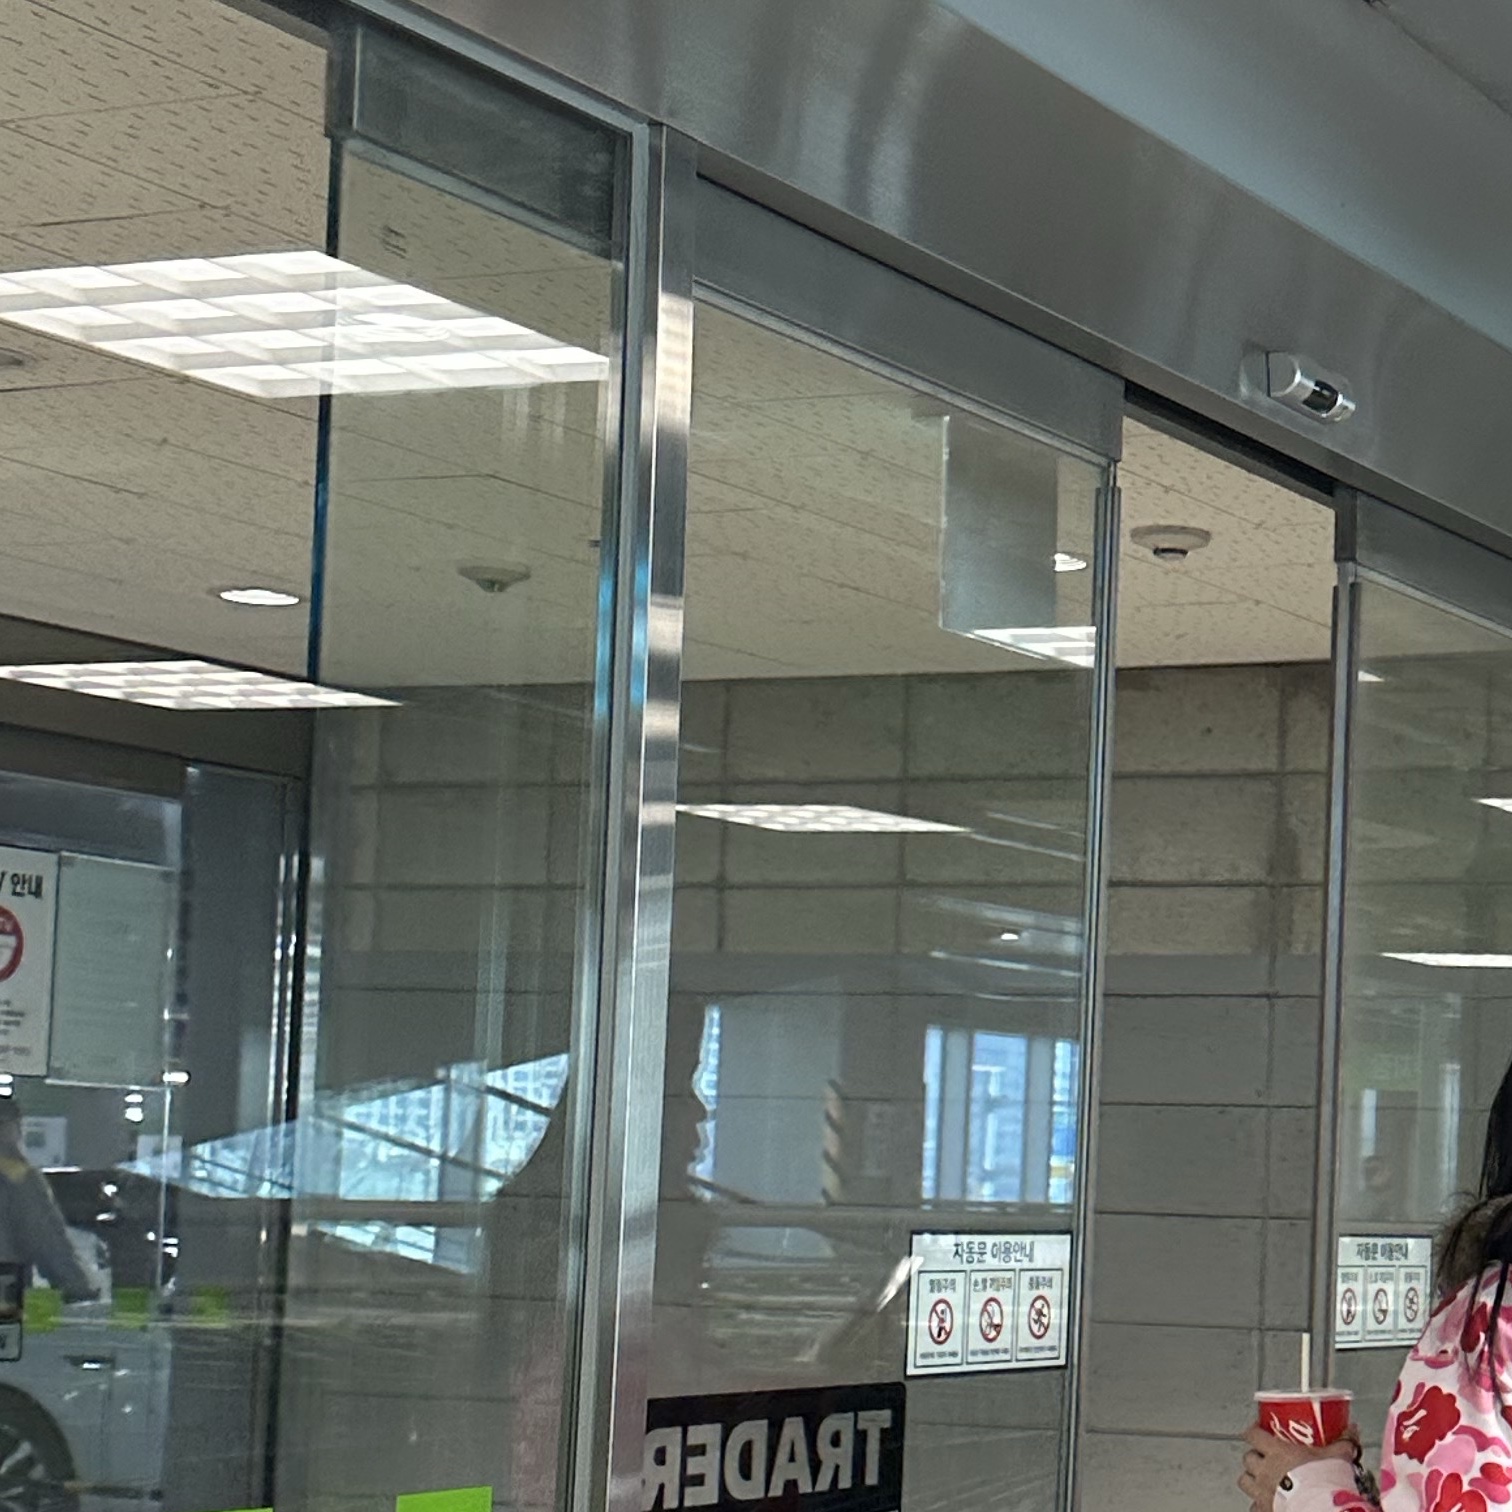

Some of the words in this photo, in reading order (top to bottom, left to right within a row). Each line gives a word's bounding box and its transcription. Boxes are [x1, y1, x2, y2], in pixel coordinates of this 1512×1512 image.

[11, 873, 44, 899] 안내
[953, 1240, 988, 1265] 자동문
[991, 1240, 1035, 1263] 이용안내
